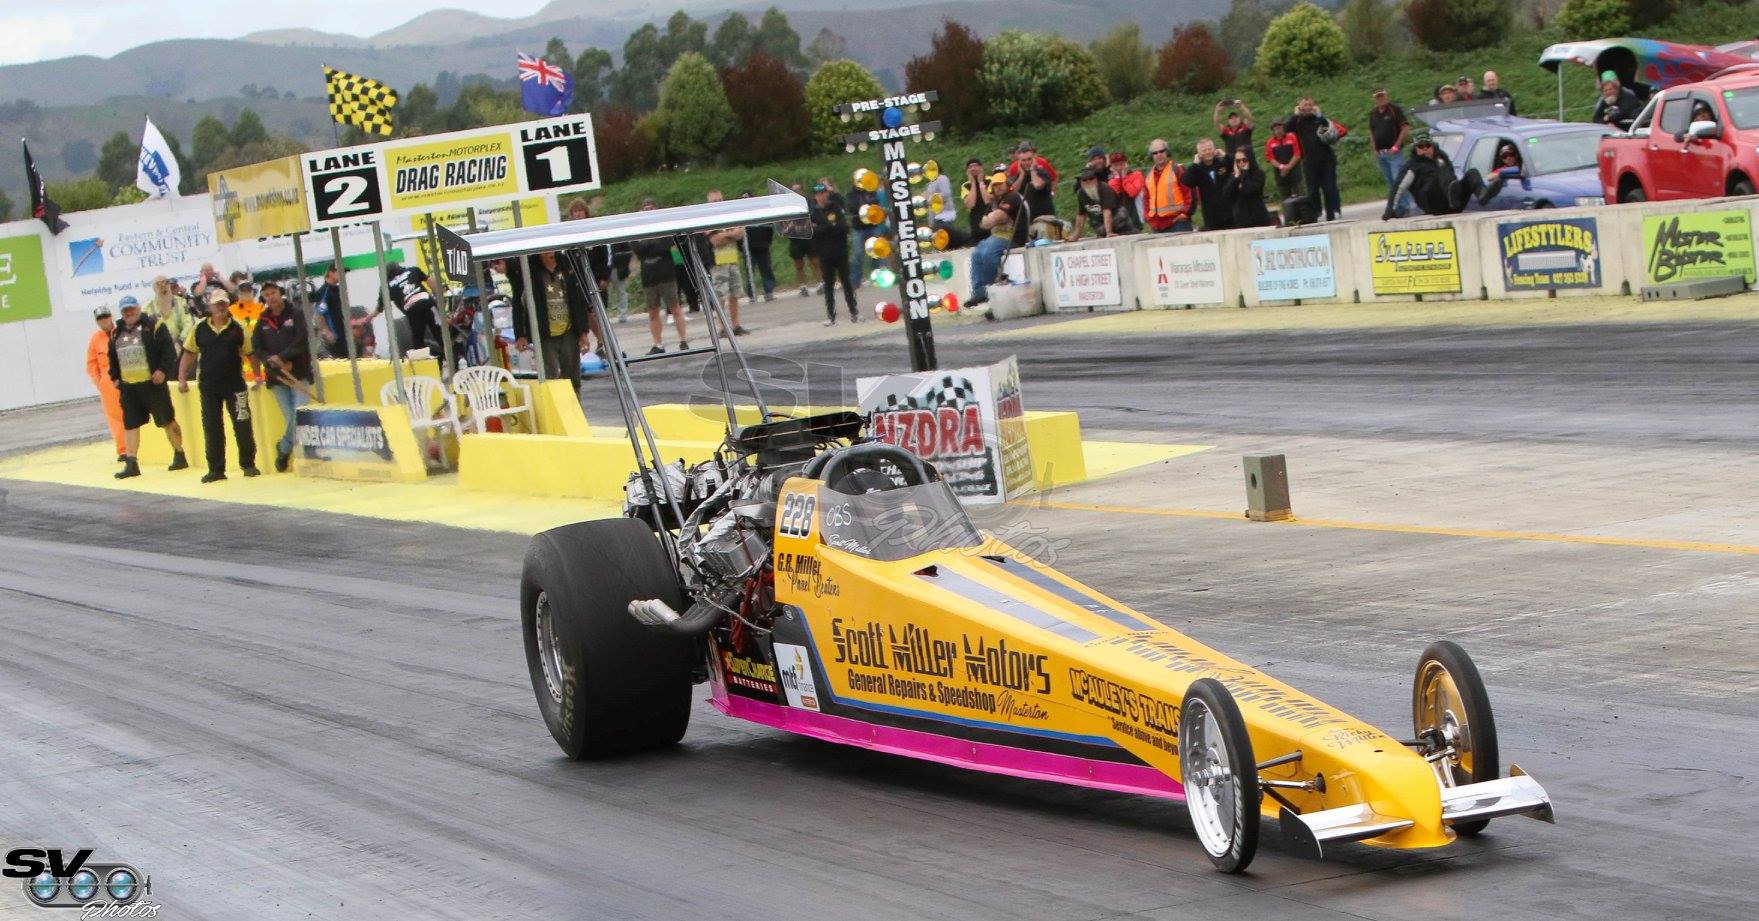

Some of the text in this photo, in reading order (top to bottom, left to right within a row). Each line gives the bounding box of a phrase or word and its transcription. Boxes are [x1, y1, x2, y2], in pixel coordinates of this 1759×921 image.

[852, 93, 927, 112] PRE-STAGE
[520, 122, 586, 142] LANE
[869, 125, 921, 140] STAGE
[310, 151, 376, 172] LANE
[396, 155, 508, 194] DRAG RACING
[536, 145, 572, 182] 1
[324, 176, 370, 214] 2
[109, 231, 211, 258] COMMUNITY
[883, 141, 929, 320] MASTERTON
[1503, 223, 1592, 258] LIFESTYLERS
[137, 250, 186, 268] TRUST
[873, 405, 986, 460] NZDRA
[778, 493, 816, 540] 228
[795, 554, 822, 576] Miller
[832, 618, 1051, 695] Scott Miller Motors
[733, 676, 774, 692] BATTERIES
[848, 668, 1050, 721] General Repairs & Speedshop Masterton
[1134, 726, 1152, 745] above
[1152, 735, 1164, 750] and
